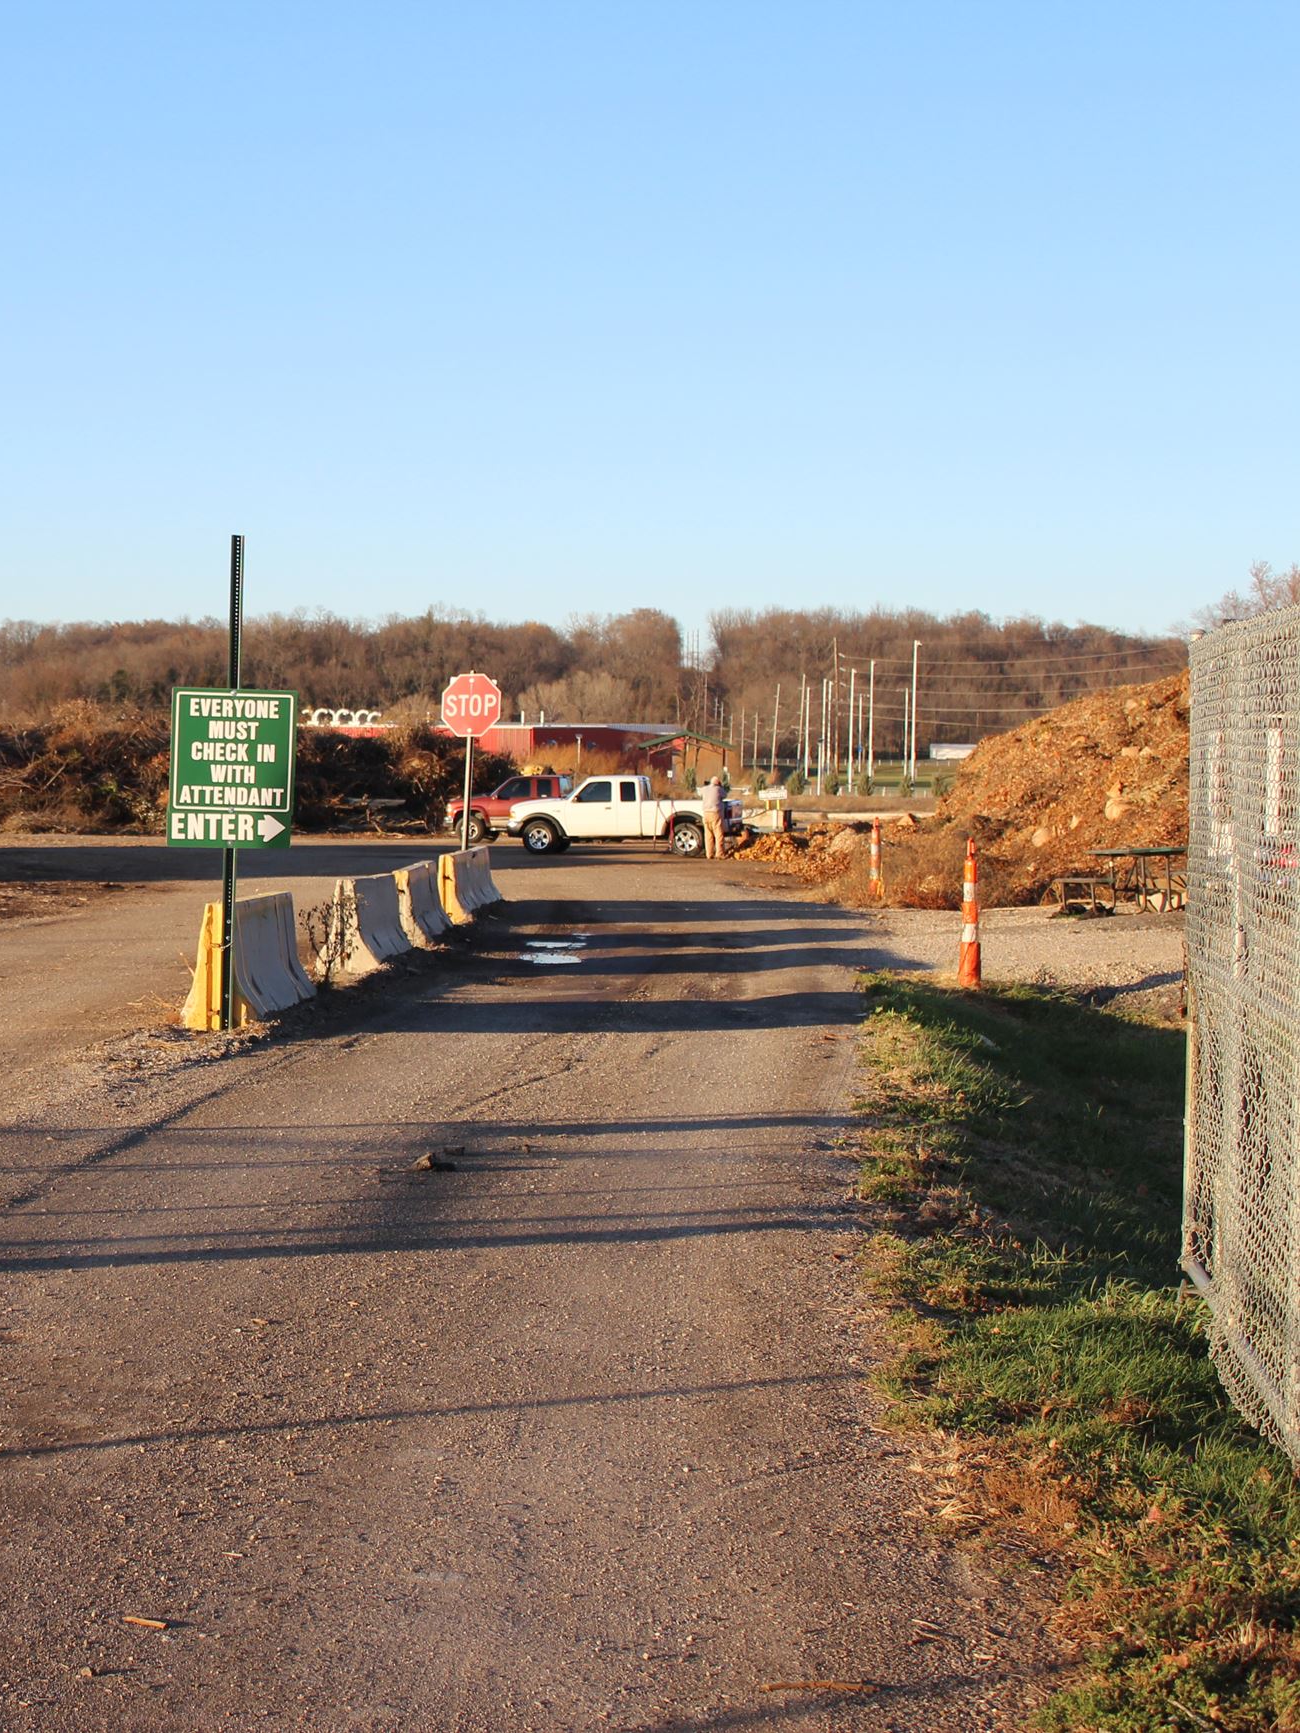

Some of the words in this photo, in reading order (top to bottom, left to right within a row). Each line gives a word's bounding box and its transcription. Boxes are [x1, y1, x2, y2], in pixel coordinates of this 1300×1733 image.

[189, 698, 280, 719] EVERYONE
[445, 694, 497, 717] STOP
[208, 720, 259, 740] MUST
[191, 741, 249, 762] CHECK
[256, 744, 276, 763] IN
[210, 764, 256, 784] WITH
[179, 785, 284, 806] ATTENDANT
[171, 812, 254, 841] ENTER
